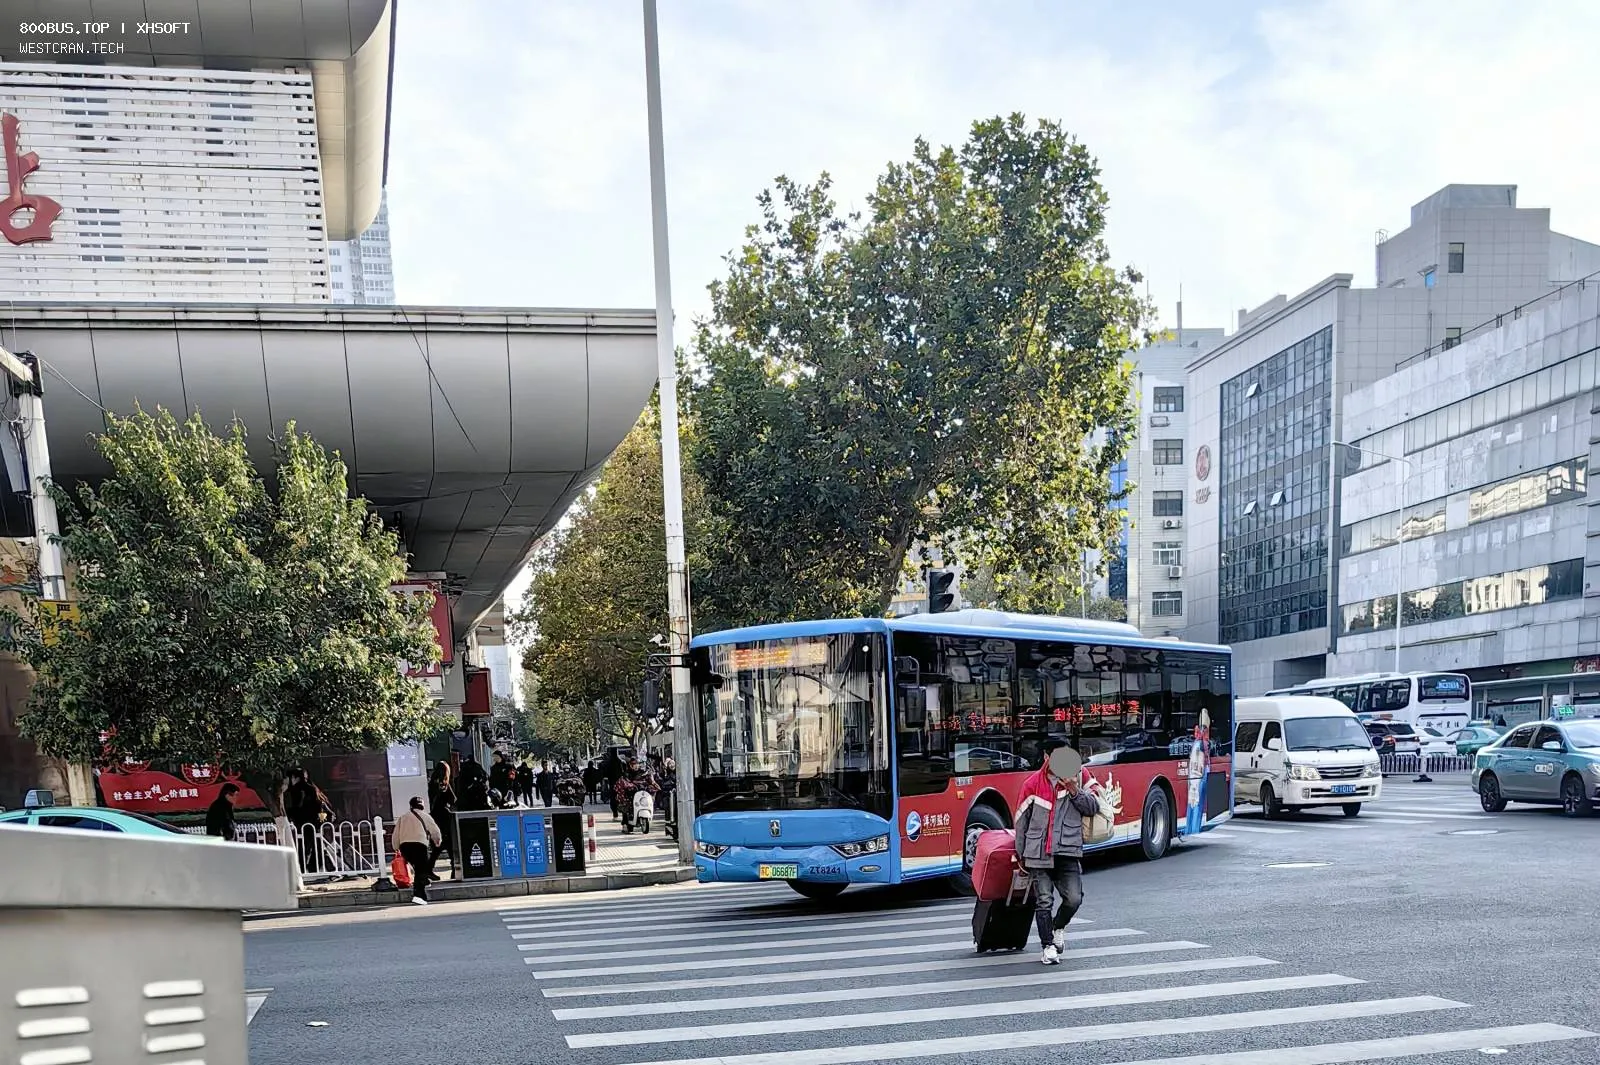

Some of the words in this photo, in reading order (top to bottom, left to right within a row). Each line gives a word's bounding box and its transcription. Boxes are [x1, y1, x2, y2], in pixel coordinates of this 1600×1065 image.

[113, 784, 199, 802] 社会主义核心价值观
